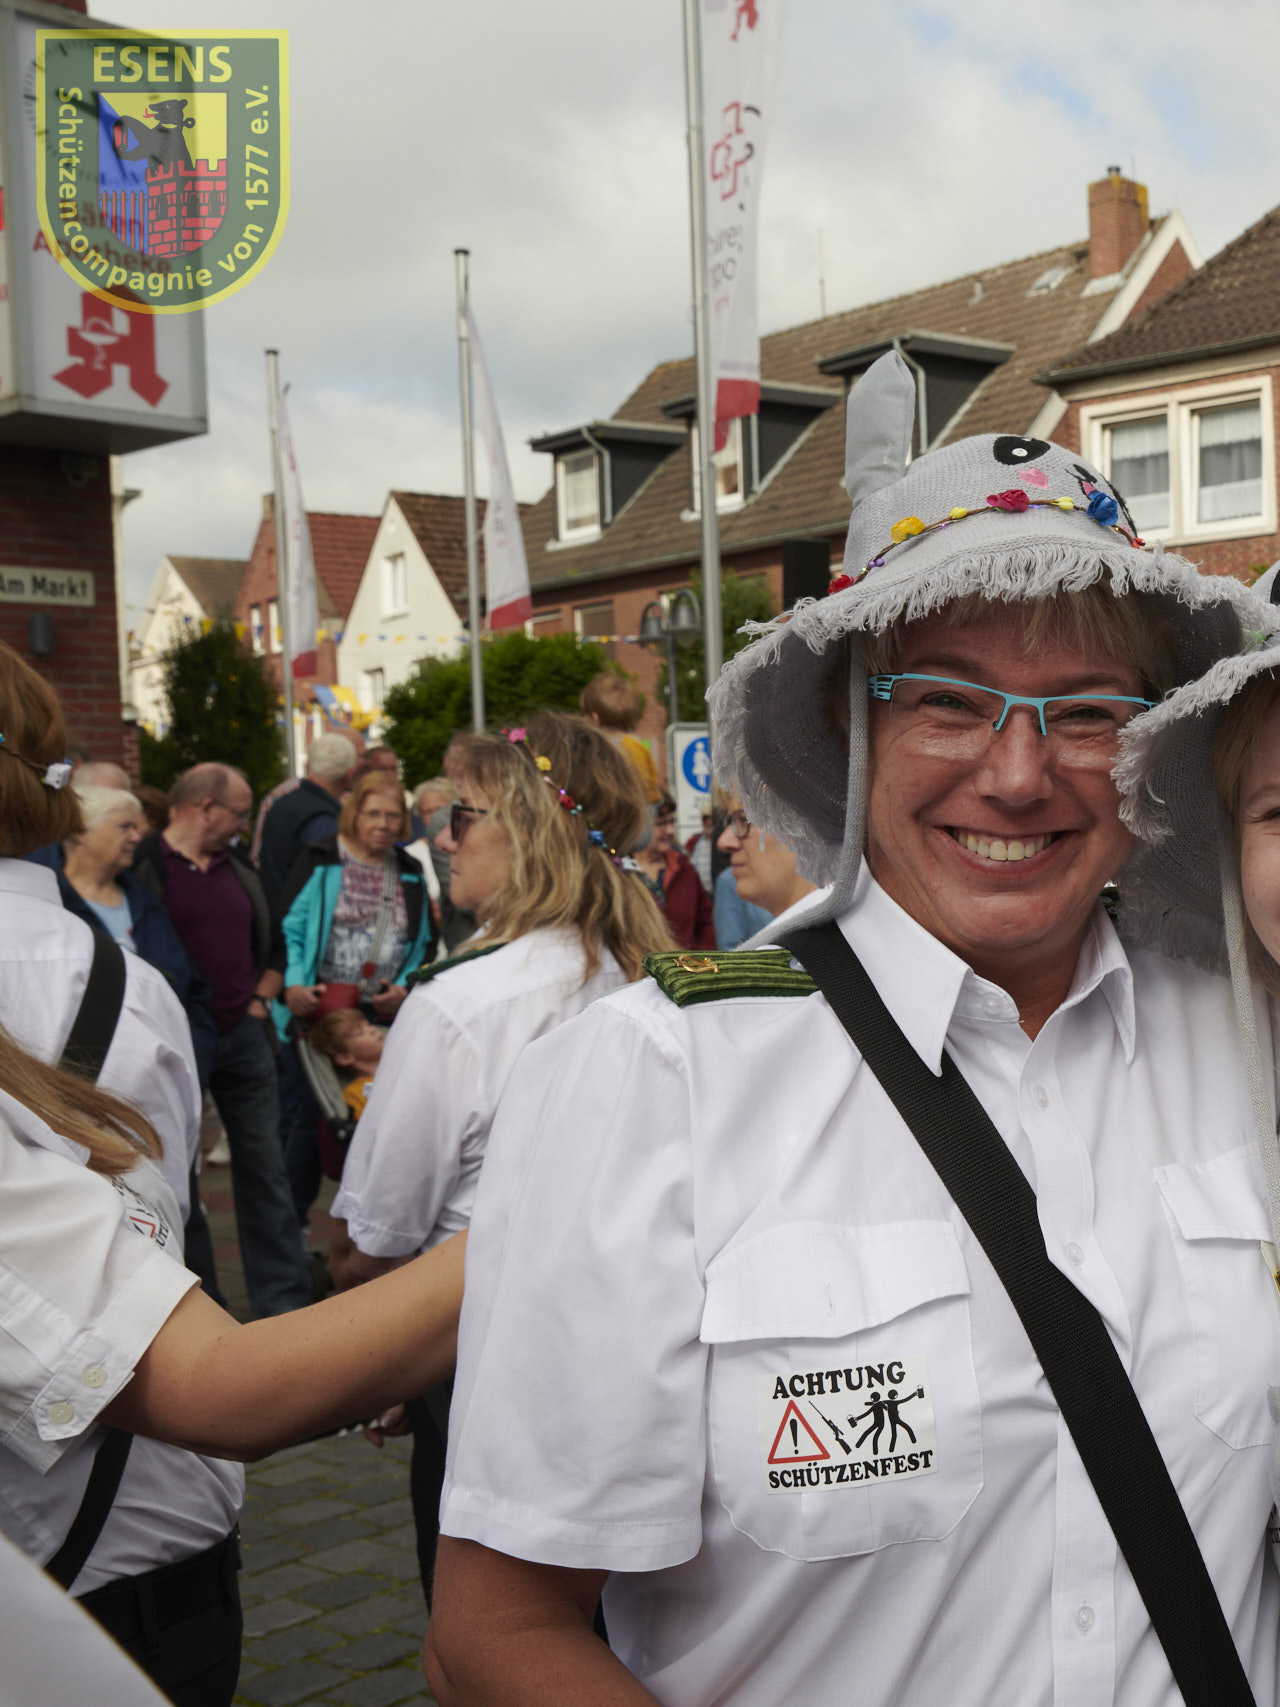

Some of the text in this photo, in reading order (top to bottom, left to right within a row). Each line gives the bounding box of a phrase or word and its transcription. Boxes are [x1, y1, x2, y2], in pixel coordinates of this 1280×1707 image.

[31, 574, 87, 598] Markt
[772, 1361, 906, 1400] ACHTUNG
[768, 1449, 934, 1489] SCHÜTZENFEST
